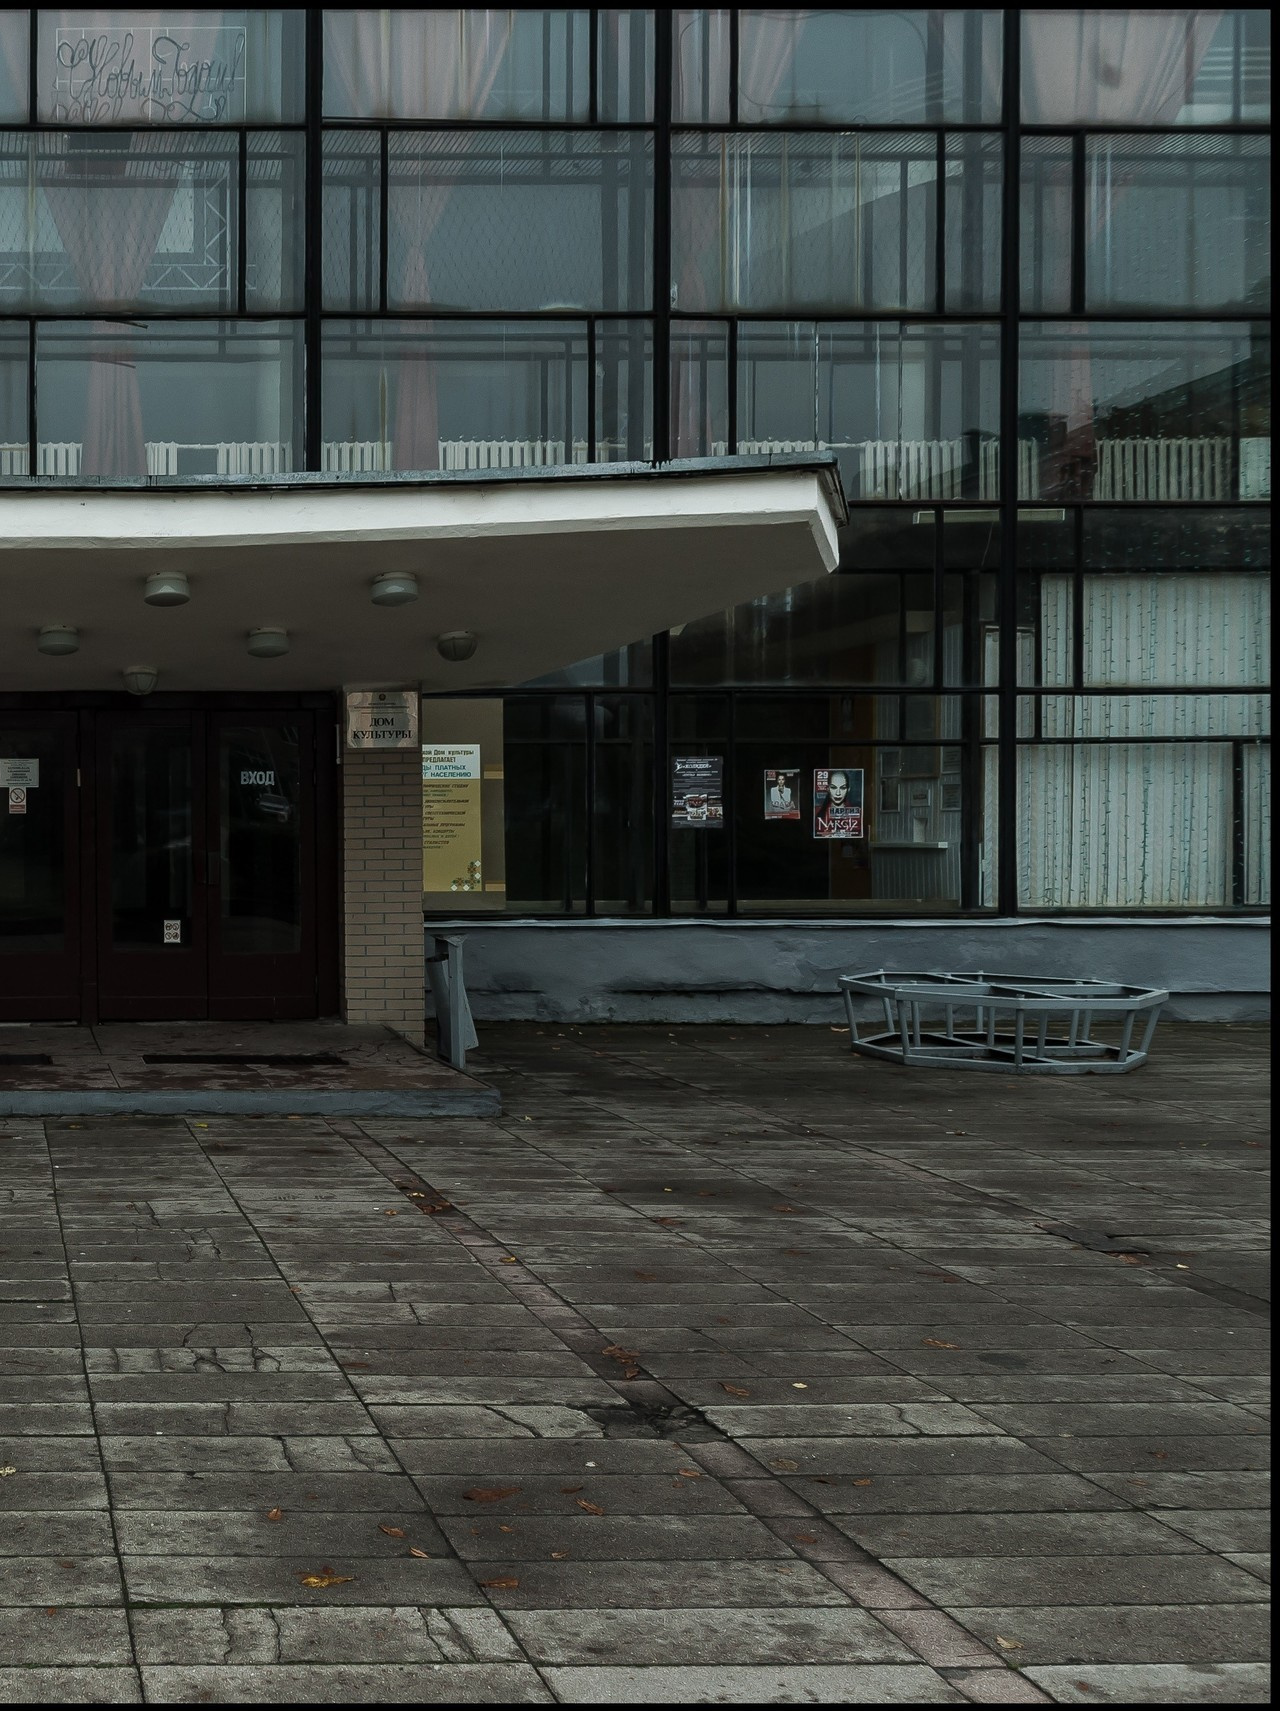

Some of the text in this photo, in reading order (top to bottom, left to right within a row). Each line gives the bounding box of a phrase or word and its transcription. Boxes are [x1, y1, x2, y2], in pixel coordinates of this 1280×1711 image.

[370, 717, 394, 728] ДОМ
[353, 730, 413, 739] КУЛЬТУРЫ
[240, 770, 275, 786] ВХОД
[817, 771, 829, 779] 29
